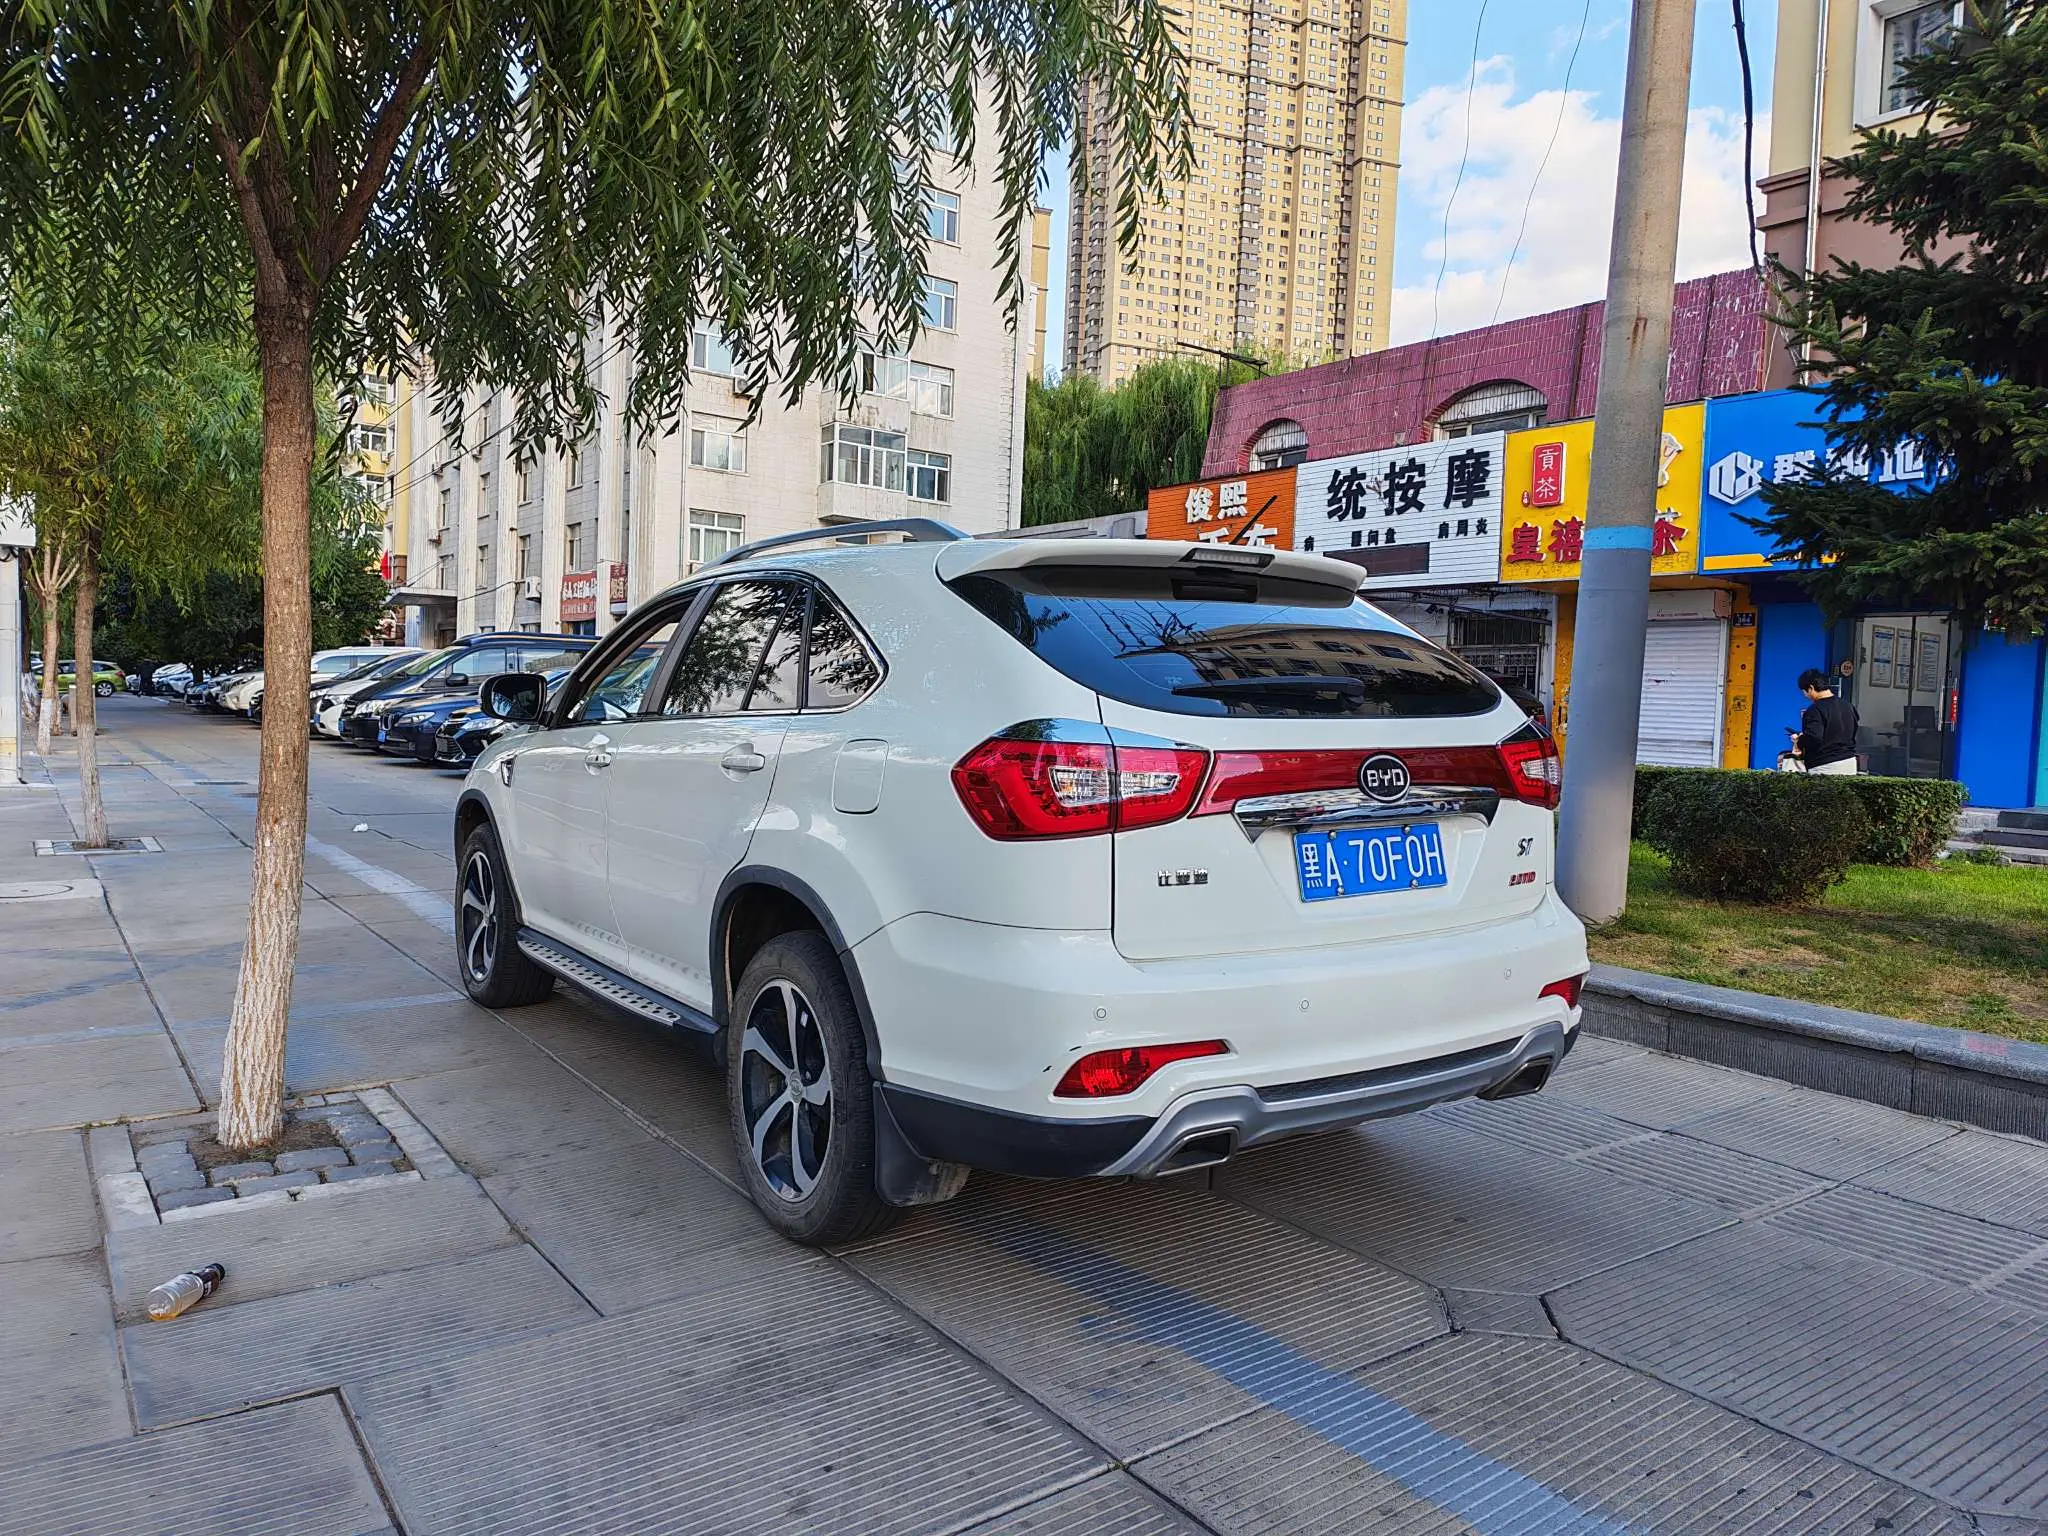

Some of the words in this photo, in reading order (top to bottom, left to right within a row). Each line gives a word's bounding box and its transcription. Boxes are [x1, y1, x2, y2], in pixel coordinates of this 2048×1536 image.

[1327, 448, 1490, 522] 统按摩
[1535, 448, 1560, 499] 貢茶
[1185, 480, 1248, 523] 俊熙
[1366, 768, 1405, 787] BYD
[1157, 869, 1208, 887] 比亚迪
